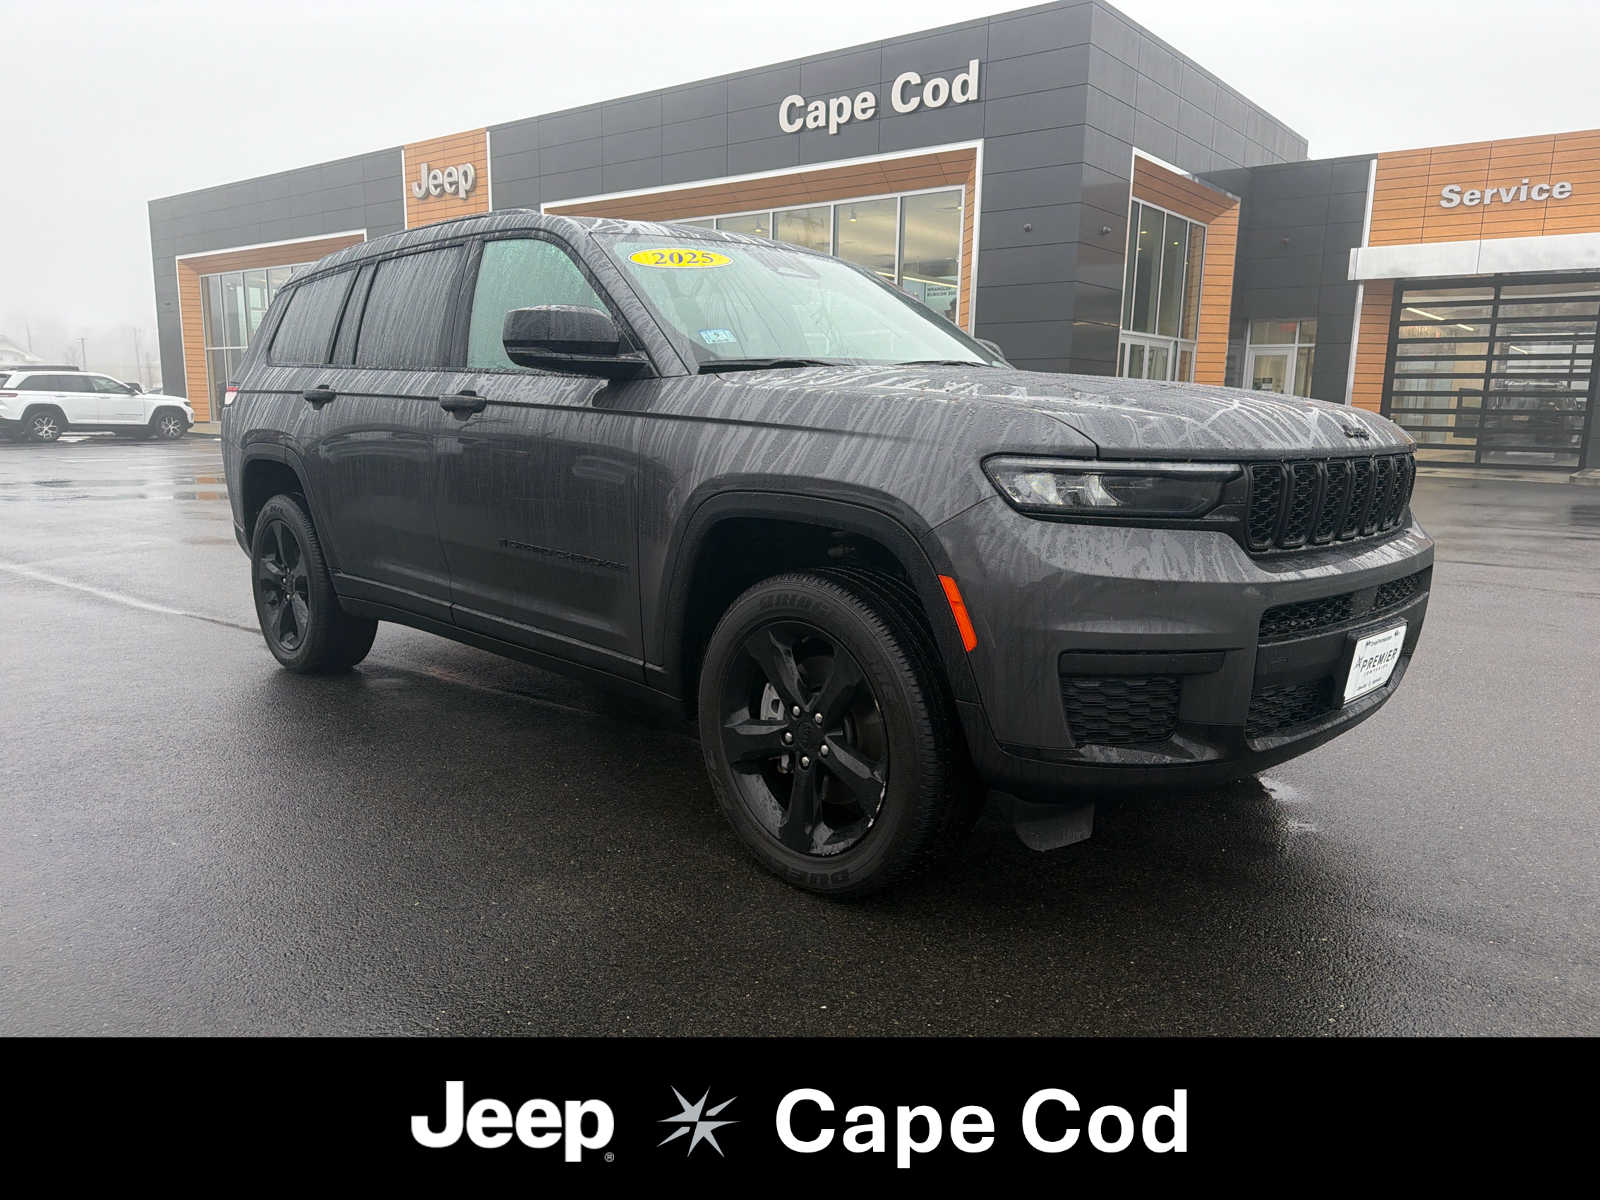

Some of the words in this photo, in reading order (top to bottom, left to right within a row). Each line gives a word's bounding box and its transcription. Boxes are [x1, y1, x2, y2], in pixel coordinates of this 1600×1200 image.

[779, 91, 876, 135] Cape
[891, 59, 980, 114] Cod
[411, 160, 476, 200] Jeep
[1439, 178, 1573, 209] Service
[652, 251, 714, 265] 2025
[1360, 648, 1398, 671] PREMIER
